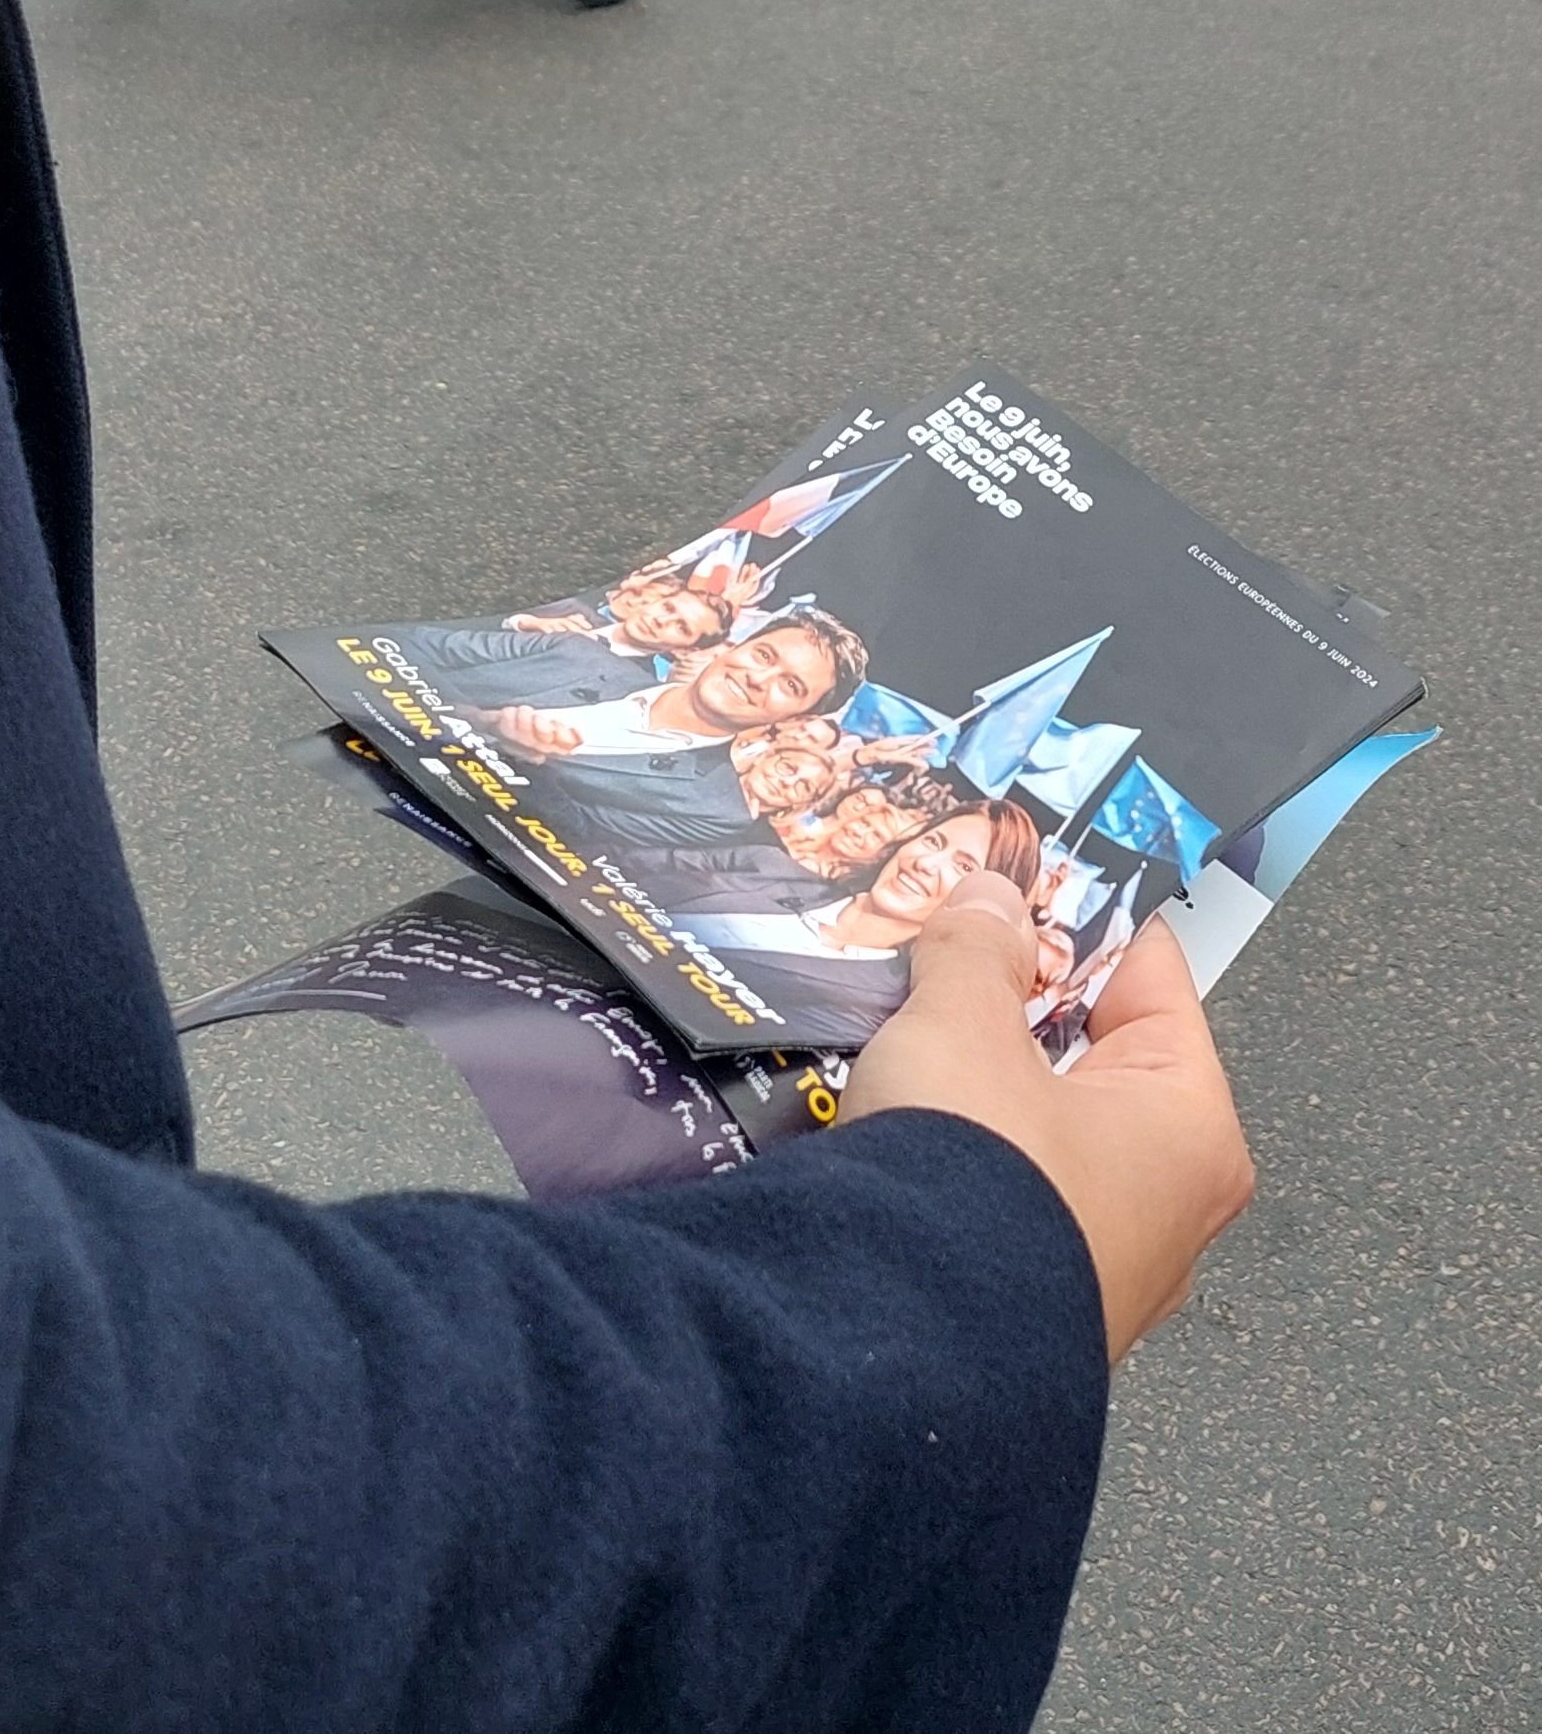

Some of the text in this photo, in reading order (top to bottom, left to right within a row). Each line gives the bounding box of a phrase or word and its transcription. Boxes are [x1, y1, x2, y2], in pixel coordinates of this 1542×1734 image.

[907, 425, 1022, 519] d'Europe
[925, 408, 1017, 484] Besoin
[945, 397, 1093, 512] nous avons
[964, 381, 1071, 472] Le 9 juin,
[1187, 545, 1379, 689] ÉLECTIONS EUROPÉENNES DU 9 JUIN 2024
[352, 690, 416, 747] RENAISSANCE
[372, 637, 455, 712] Gabriel
[438, 714, 530, 785] Attal
[336, 638, 379, 665] LE
[365, 668, 393, 684] 9
[381, 688, 443, 741] JUIN.
[441, 744, 465, 755] 1
[457, 759, 518, 812] SEUL
[515, 816, 588, 877] JOUR.
[591, 882, 616, 895] 1
[609, 900, 675, 956] SEUL
[677, 961, 755, 1024] TOUR
[388, 792, 473, 848] RENAISSANCE
[591, 855, 674, 928] Valérie
[670, 931, 787, 1024] Hayer
